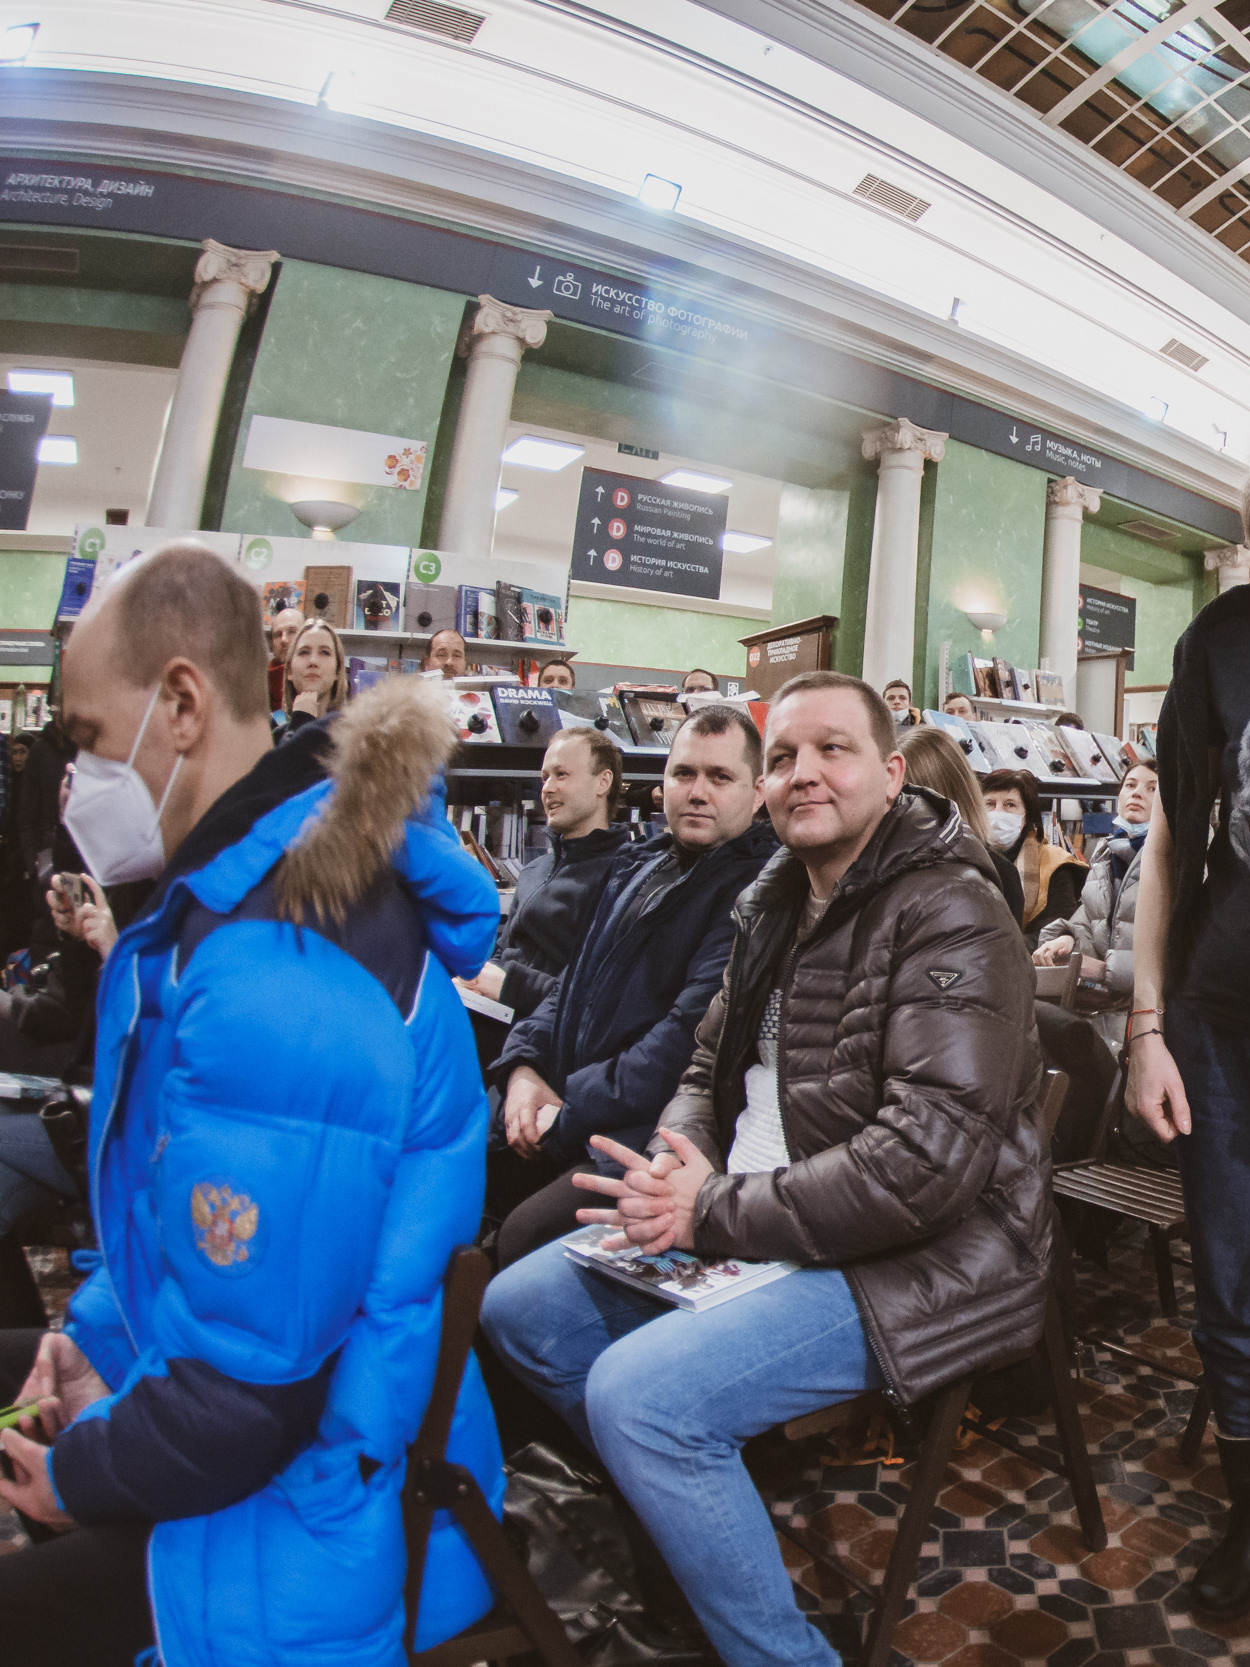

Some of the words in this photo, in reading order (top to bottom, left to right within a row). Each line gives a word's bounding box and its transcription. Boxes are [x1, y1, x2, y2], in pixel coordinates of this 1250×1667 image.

[6, 173, 95, 194] АРХИТЕКТУРА,
[97, 179, 155, 198] ДИЗАЙН
[72, 193, 113, 210] Design
[590, 294, 610, 311] The
[614, 303, 631, 317] art
[633, 310, 646, 321] of
[648, 314, 717, 345] photography
[592, 282, 665, 314] ИСКУССТВО
[667, 306, 749, 341] ФОТОГРАФИИ
[1045, 449, 1067, 466] Music,
[1067, 459, 1086, 472] notes
[1046, 440, 1080, 461] МУЗЫКА,
[1081, 453, 1102, 468] НОТЫ
[636, 503, 662, 515] Russian
[664, 508, 691, 521] Painting
[637, 493, 671, 506] РУССКАЯ
[672, 500, 714, 515] ЖИВОПИСЬ
[633, 533, 646, 543] The
[647, 536, 666, 547] world
[667, 539, 675, 548] of
[676, 542, 686, 550] art
[634, 524, 671, 537] МИРОВАЯ
[672, 531, 714, 545] ЖИВОПИСЬ
[250, 548, 267, 562] C2
[631, 554, 666, 567] ИСТОРИЯ
[667, 560, 709, 574] ИСКУССТВА
[419, 562, 436, 575] C3
[629, 564, 654, 576] History
[655, 567, 663, 576] of
[664, 570, 674, 578] art
[767, 644, 799, 656] ПРИКЛАДНОЕ
[769, 653, 796, 664] ИСКУССТВО
[497, 687, 552, 700] DRAMA
